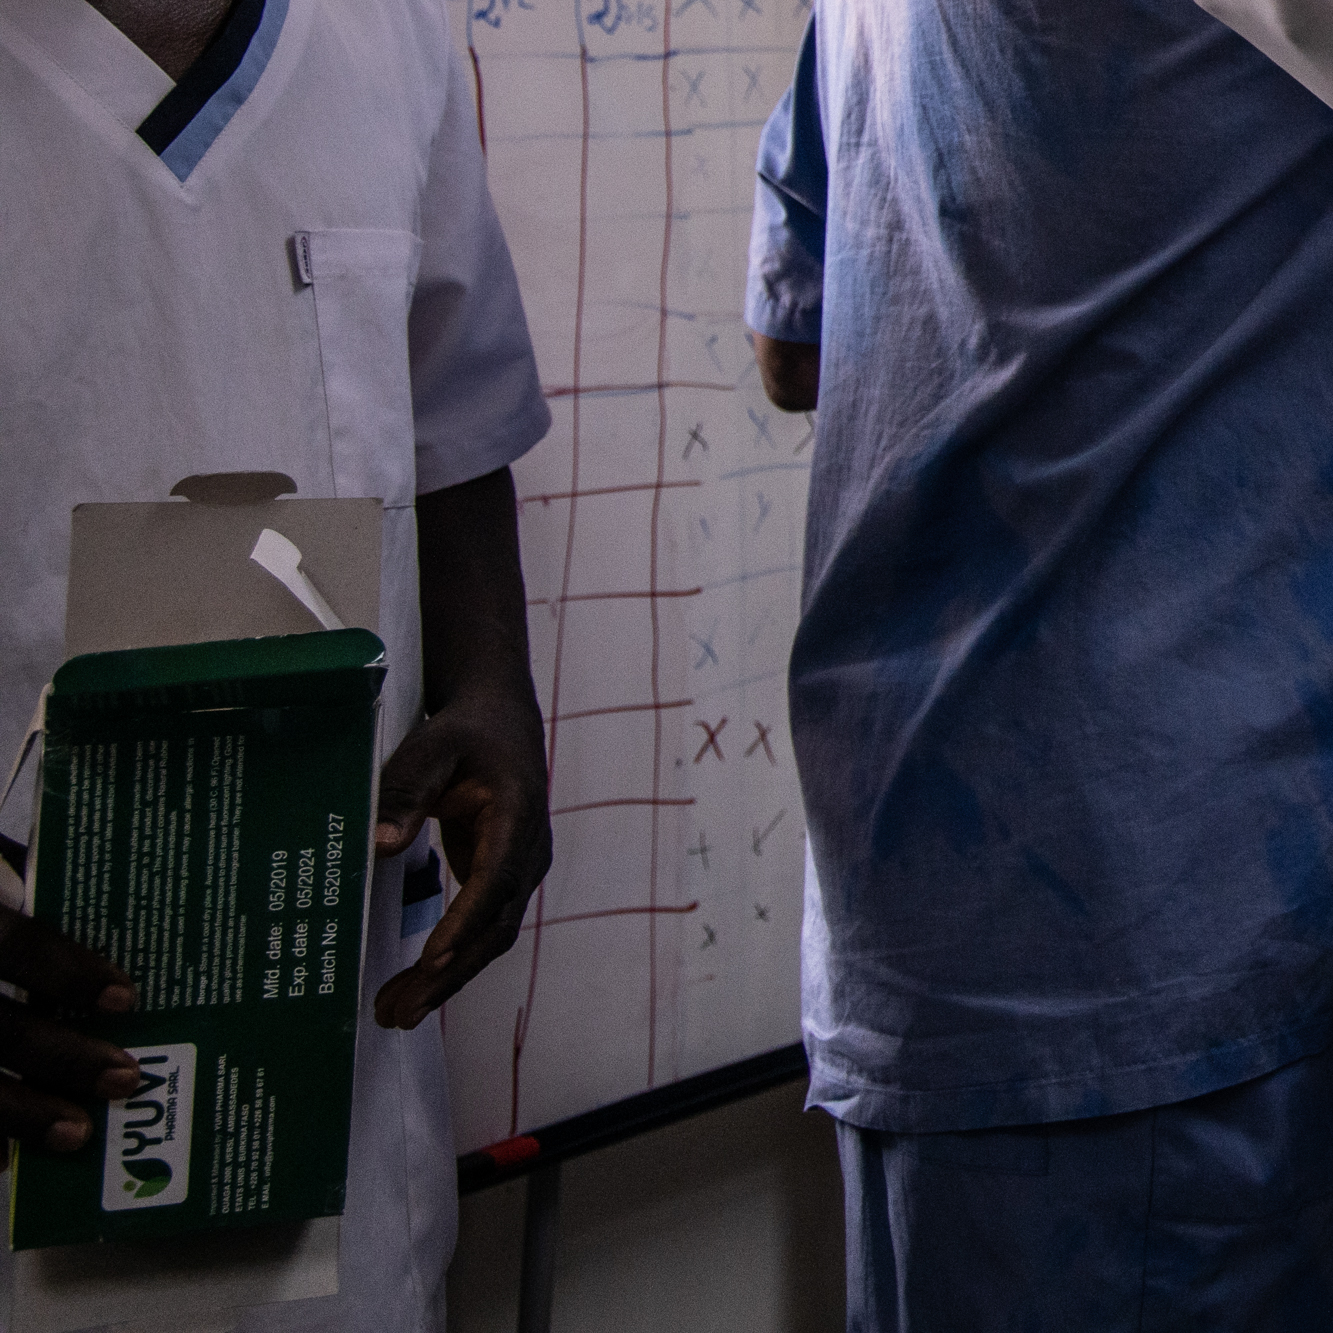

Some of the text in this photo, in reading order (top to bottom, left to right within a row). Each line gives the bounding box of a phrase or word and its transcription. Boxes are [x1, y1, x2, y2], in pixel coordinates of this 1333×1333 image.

[319, 813, 344, 994] Batch No: 0520192127
[263, 850, 289, 998] Mfd. date: 05/2019
[289, 848, 315, 997] Exp. date: 05/2024
[197, 974, 207, 1005] Storage:
[218, 1053, 227, 1075] SARL
[165, 1066, 180, 1141] PHARMA SARL
[216, 1077, 225, 1111] PHARMA
[214, 1112, 223, 1130] YUVI
[240, 1104, 250, 1126] FASO
[238, 1127, 248, 1161] BURKINA
[237, 1167, 246, 1186] UNIS
[222, 1185, 231, 1214] OUAGA
[235, 1188, 244, 1212] ETATS
[248, 1195, 257, 1210] TEL
